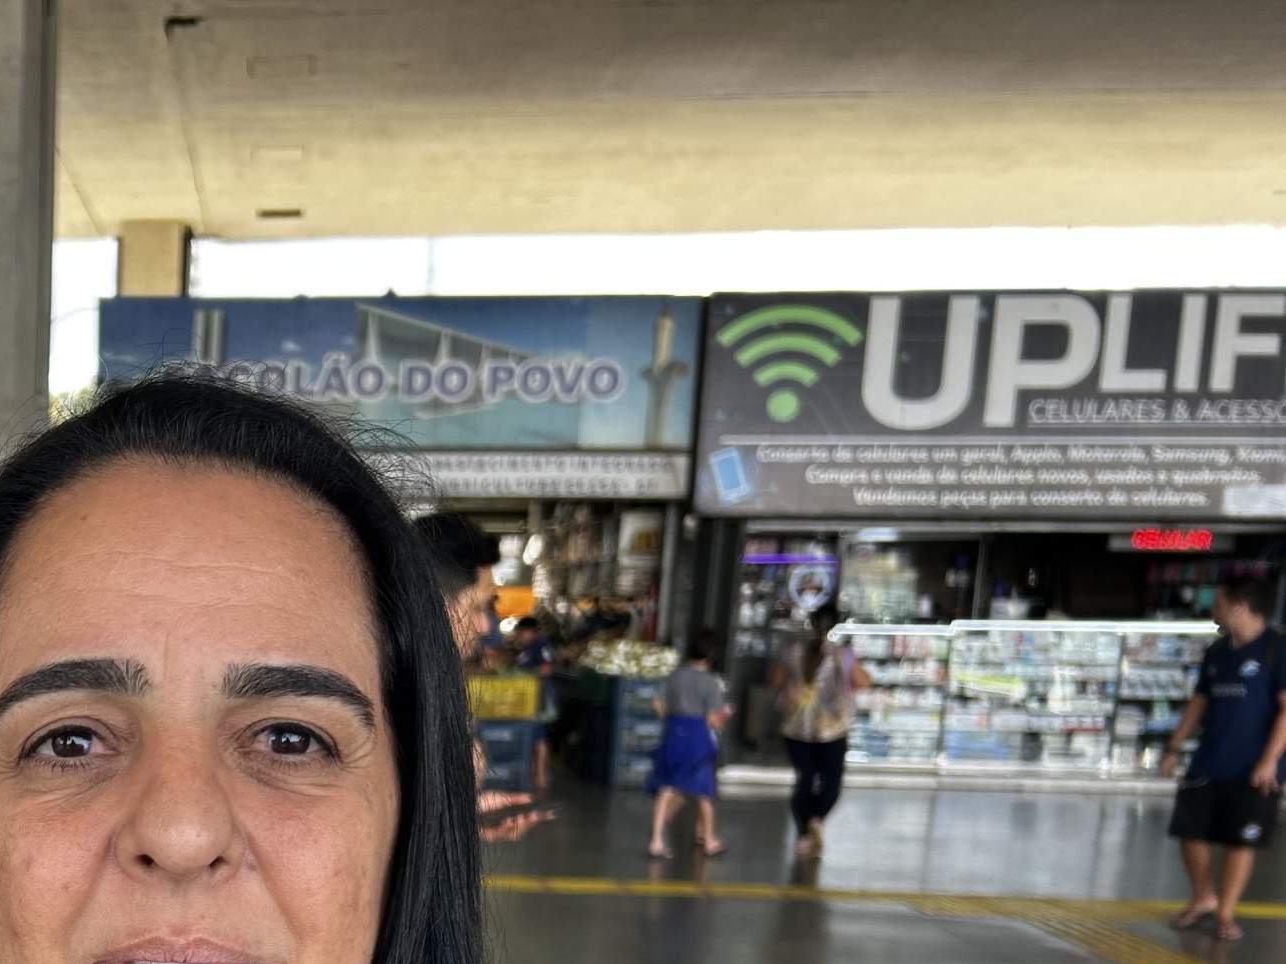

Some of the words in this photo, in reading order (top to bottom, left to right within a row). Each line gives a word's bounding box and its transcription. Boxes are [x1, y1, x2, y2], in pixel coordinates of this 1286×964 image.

[861, 294, 1286, 430] UPLIF
[164, 351, 388, 400] COLÃO
[399, 360, 471, 400] DO
[488, 359, 623, 400] POVO
[1028, 399, 1165, 423] CELULARES
[1172, 400, 1190, 423] &
[756, 443, 830, 463] Conserto
[832, 443, 854, 463] de
[856, 443, 931, 463] celulares
[932, 447, 958, 463] em
[805, 464, 870, 486] Compra
[871, 469, 883, 484] e
[884, 465, 935, 485] venda
[936, 465, 959, 485] de
[960, 465, 1035, 485] celulares
[1095, 466, 1155, 485] usados
[1157, 471, 1168, 484] e
[852, 486, 938, 506] Vendemos
[989, 489, 1028, 509] para
[1029, 488, 1103, 506] conserto
[1105, 487, 1128, 506] de
